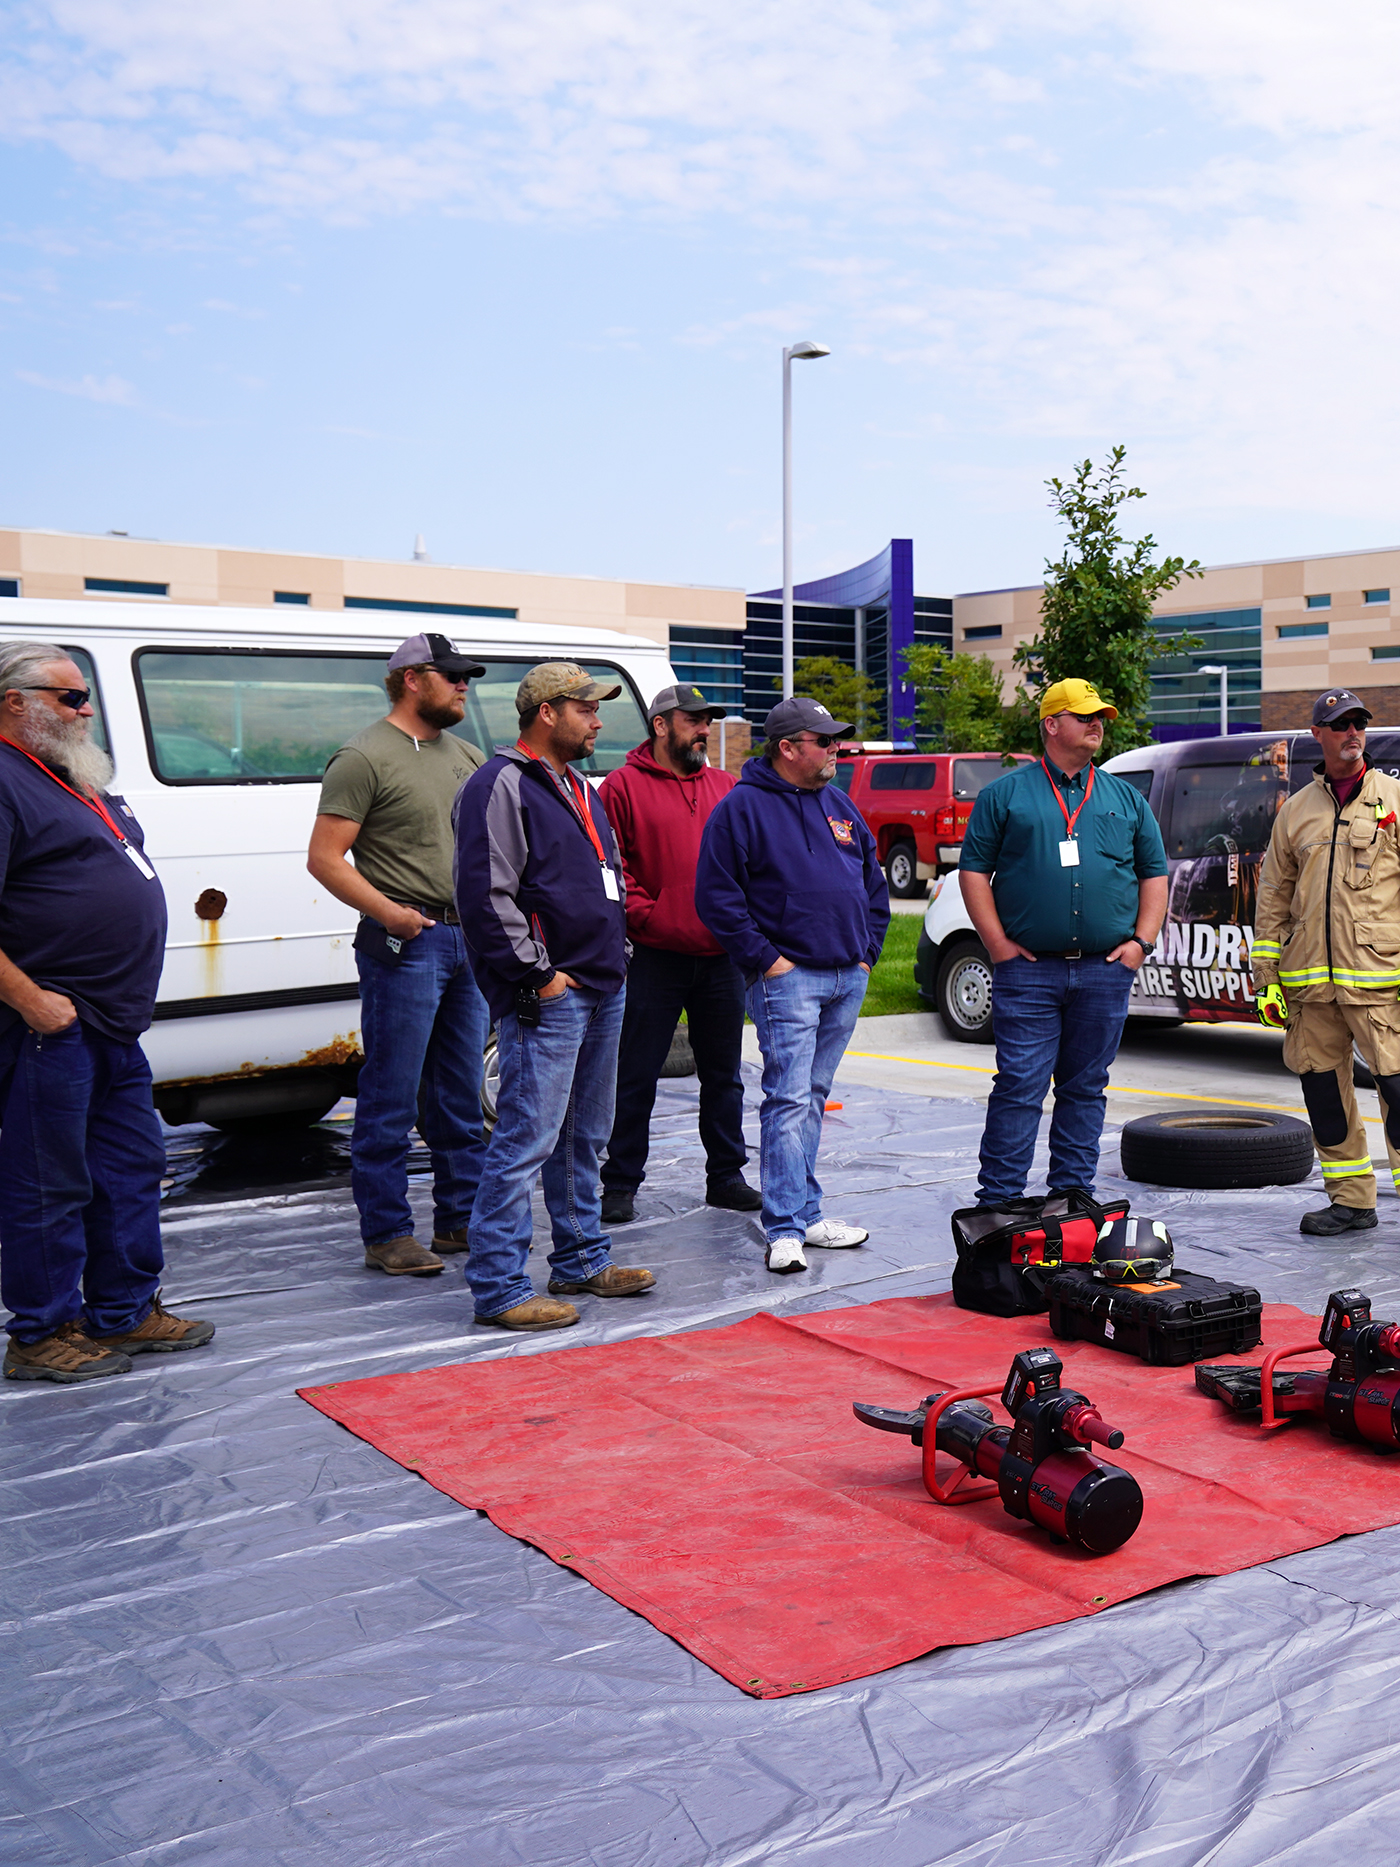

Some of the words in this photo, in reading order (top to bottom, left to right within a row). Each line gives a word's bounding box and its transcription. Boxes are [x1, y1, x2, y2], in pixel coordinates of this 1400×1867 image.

[1144, 922, 1255, 970] ANDRY
[1030, 1481, 1057, 1499] STORM
[1040, 1495, 1064, 1512] SURGE
